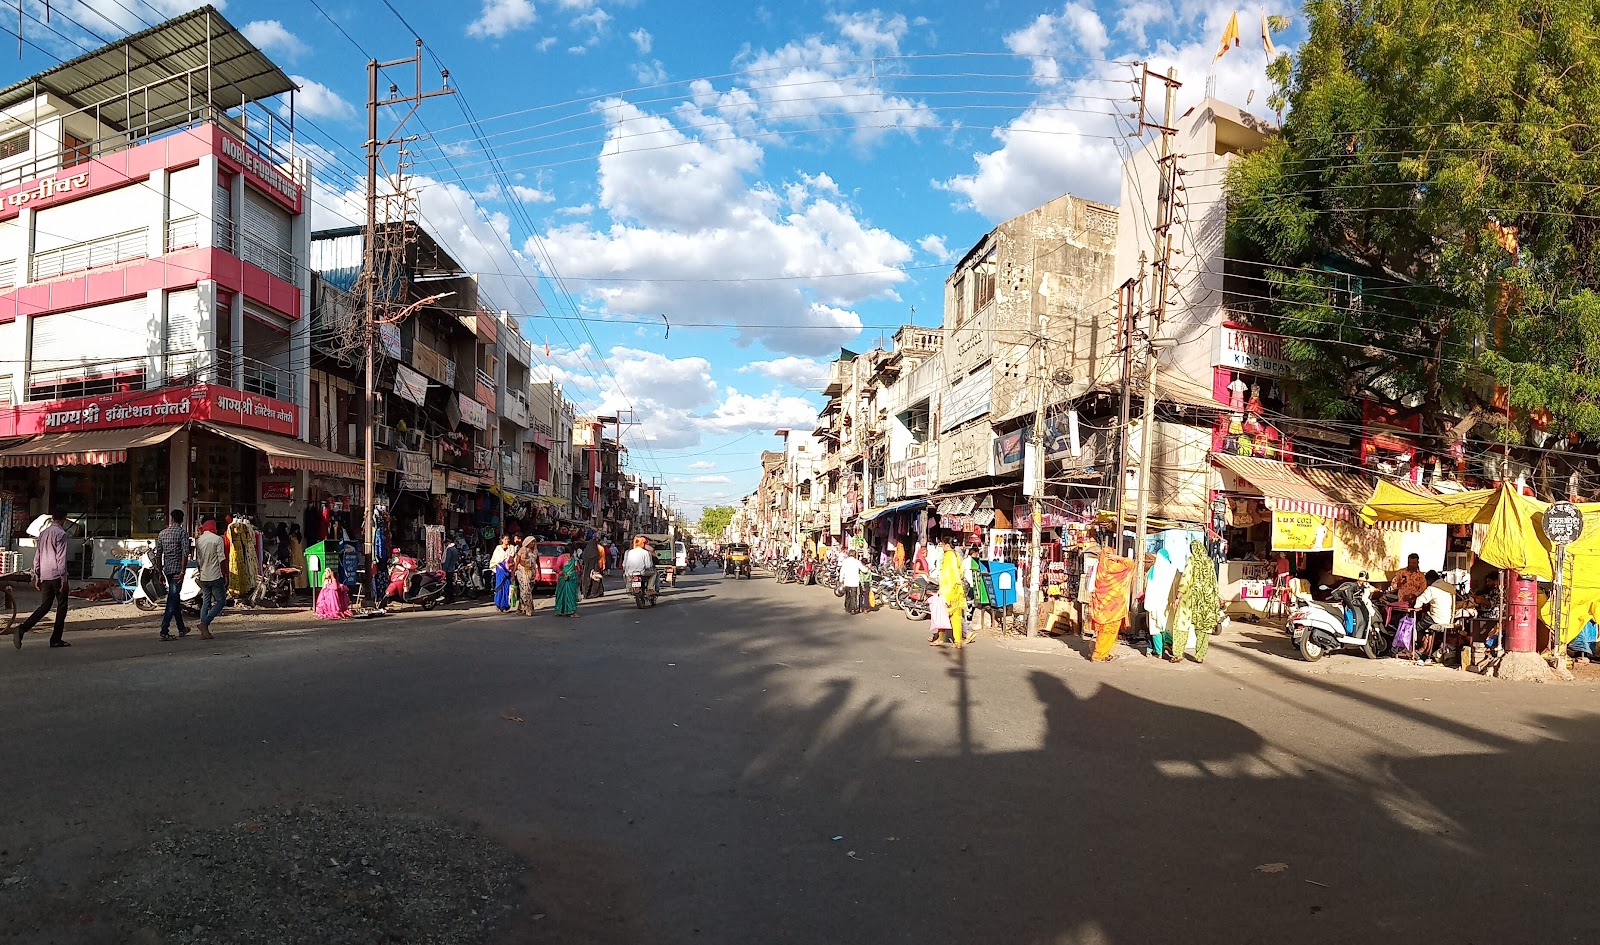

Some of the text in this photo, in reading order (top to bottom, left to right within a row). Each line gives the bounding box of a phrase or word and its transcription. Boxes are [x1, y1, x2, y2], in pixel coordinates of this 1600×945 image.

[222, 136, 298, 203] NOBLE FURNITURE
[1234, 354, 1260, 367] KIDS
[105, 403, 152, 422] इमिटेशन
[155, 398, 190, 416] ज्वेलरी
[254, 403, 276, 419] इमिटेशन
